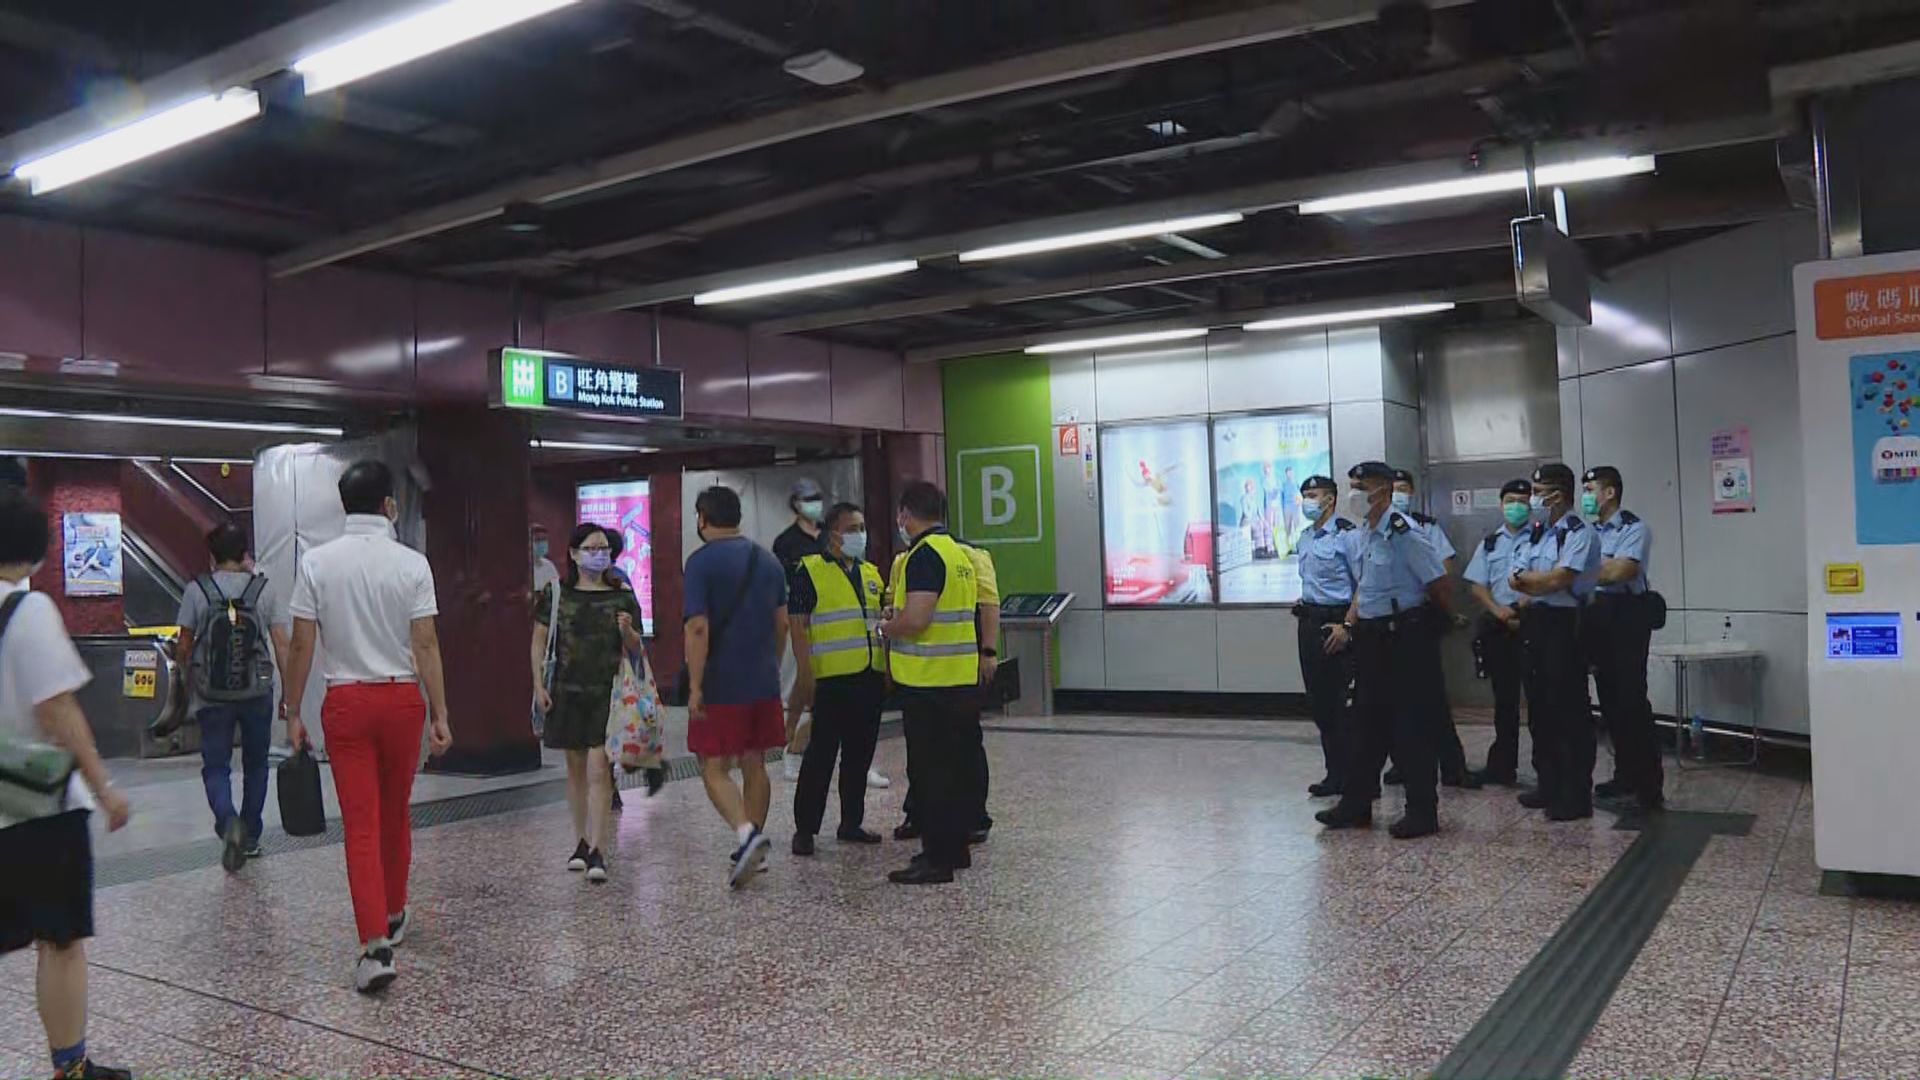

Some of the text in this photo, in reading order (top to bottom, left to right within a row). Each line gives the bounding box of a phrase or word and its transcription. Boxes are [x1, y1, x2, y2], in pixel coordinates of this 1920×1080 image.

[1845, 312, 1891, 330] Digital
[555, 370, 567, 396] B
[577, 367, 638, 395] 旺角警署
[577, 390, 664, 410] Mong Kok Police Station
[981, 465, 1017, 526] B
